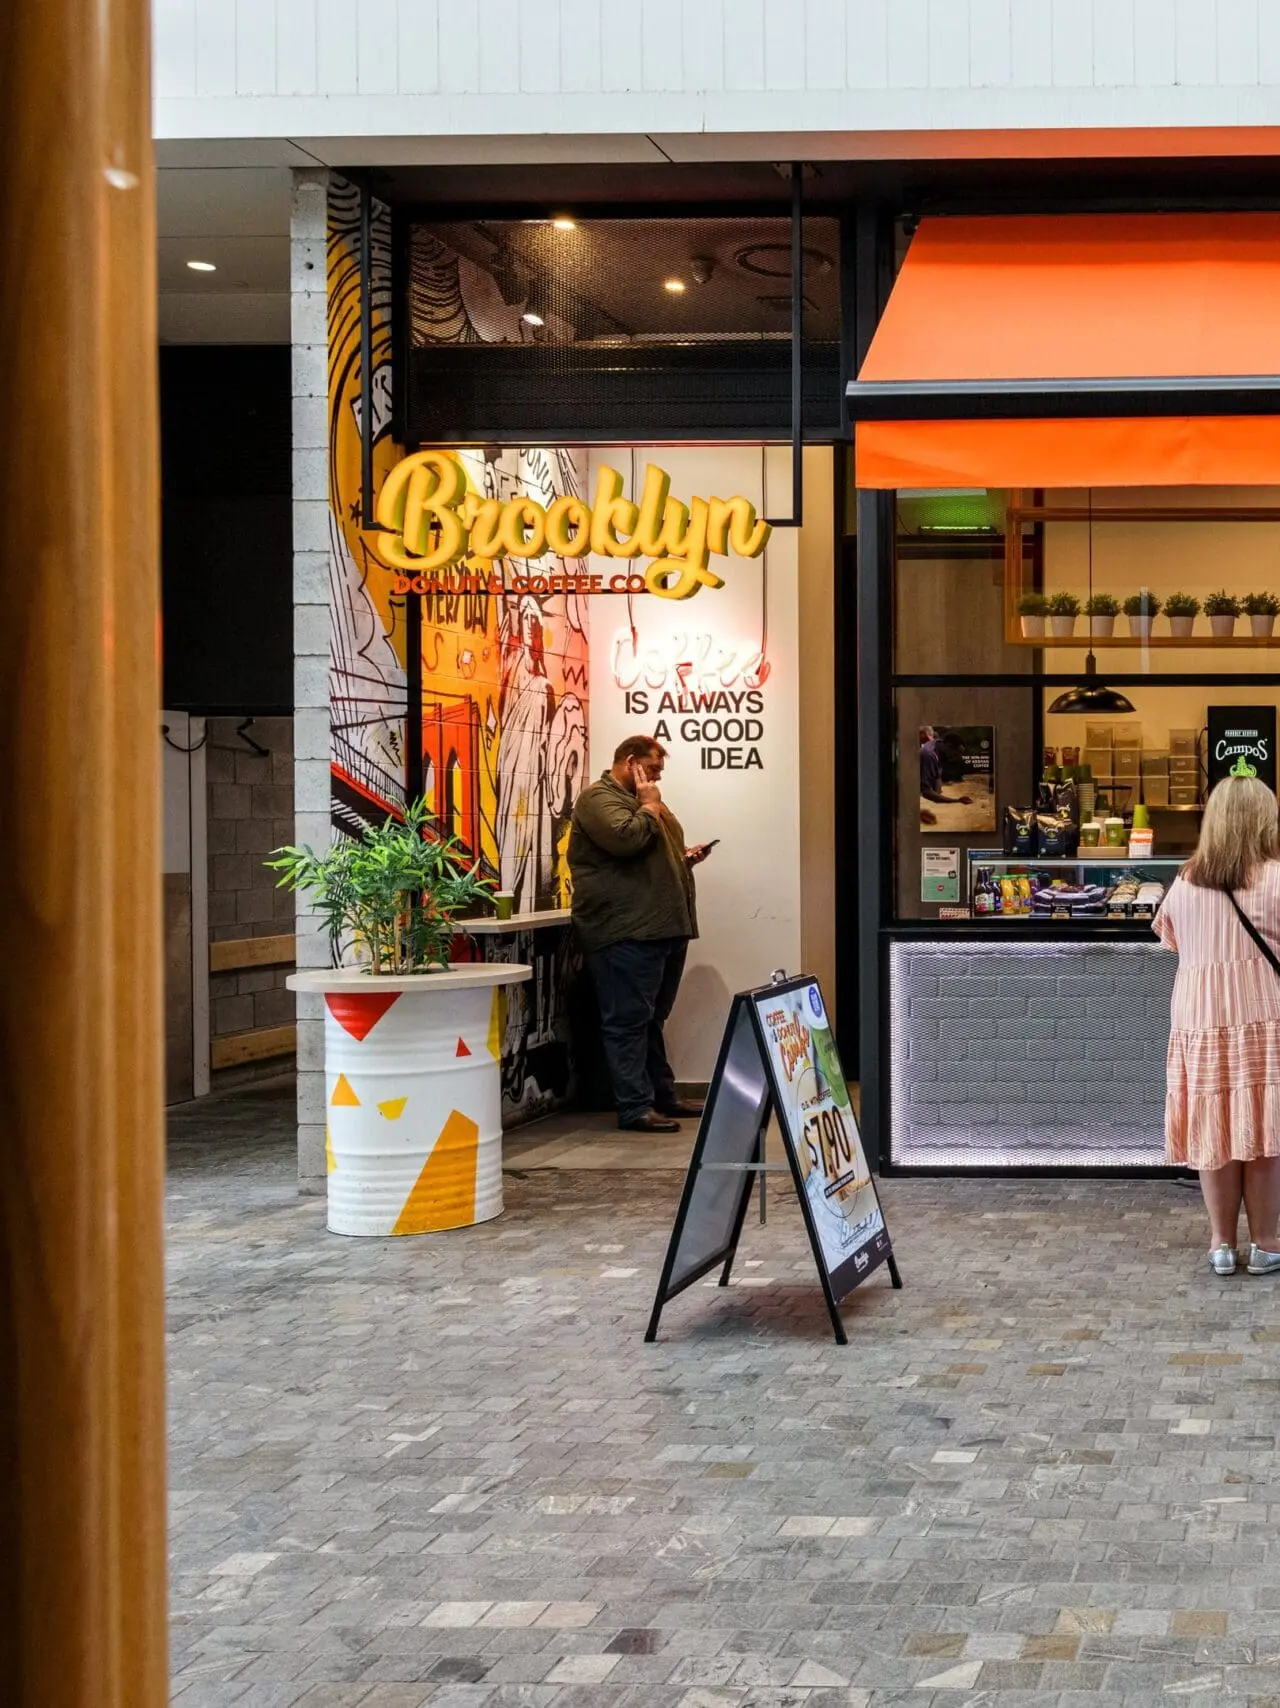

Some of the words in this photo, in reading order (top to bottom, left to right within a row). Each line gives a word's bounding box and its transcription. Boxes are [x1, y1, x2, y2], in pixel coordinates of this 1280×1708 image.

[377, 450, 773, 600] Brooklyn
[393, 575, 482, 595] DONUT
[487, 575, 506, 595] &
[512, 574, 603, 594] COFFEE
[625, 691, 649, 714] IS
[657, 691, 764, 714] ALWAYS
[653, 719, 672, 741] A
[680, 719, 764, 741] GOOD
[700, 747, 764, 769] IDEA
[766, 1009, 786, 1028] COFFEE
[804, 1105, 851, 1177] $7.90
